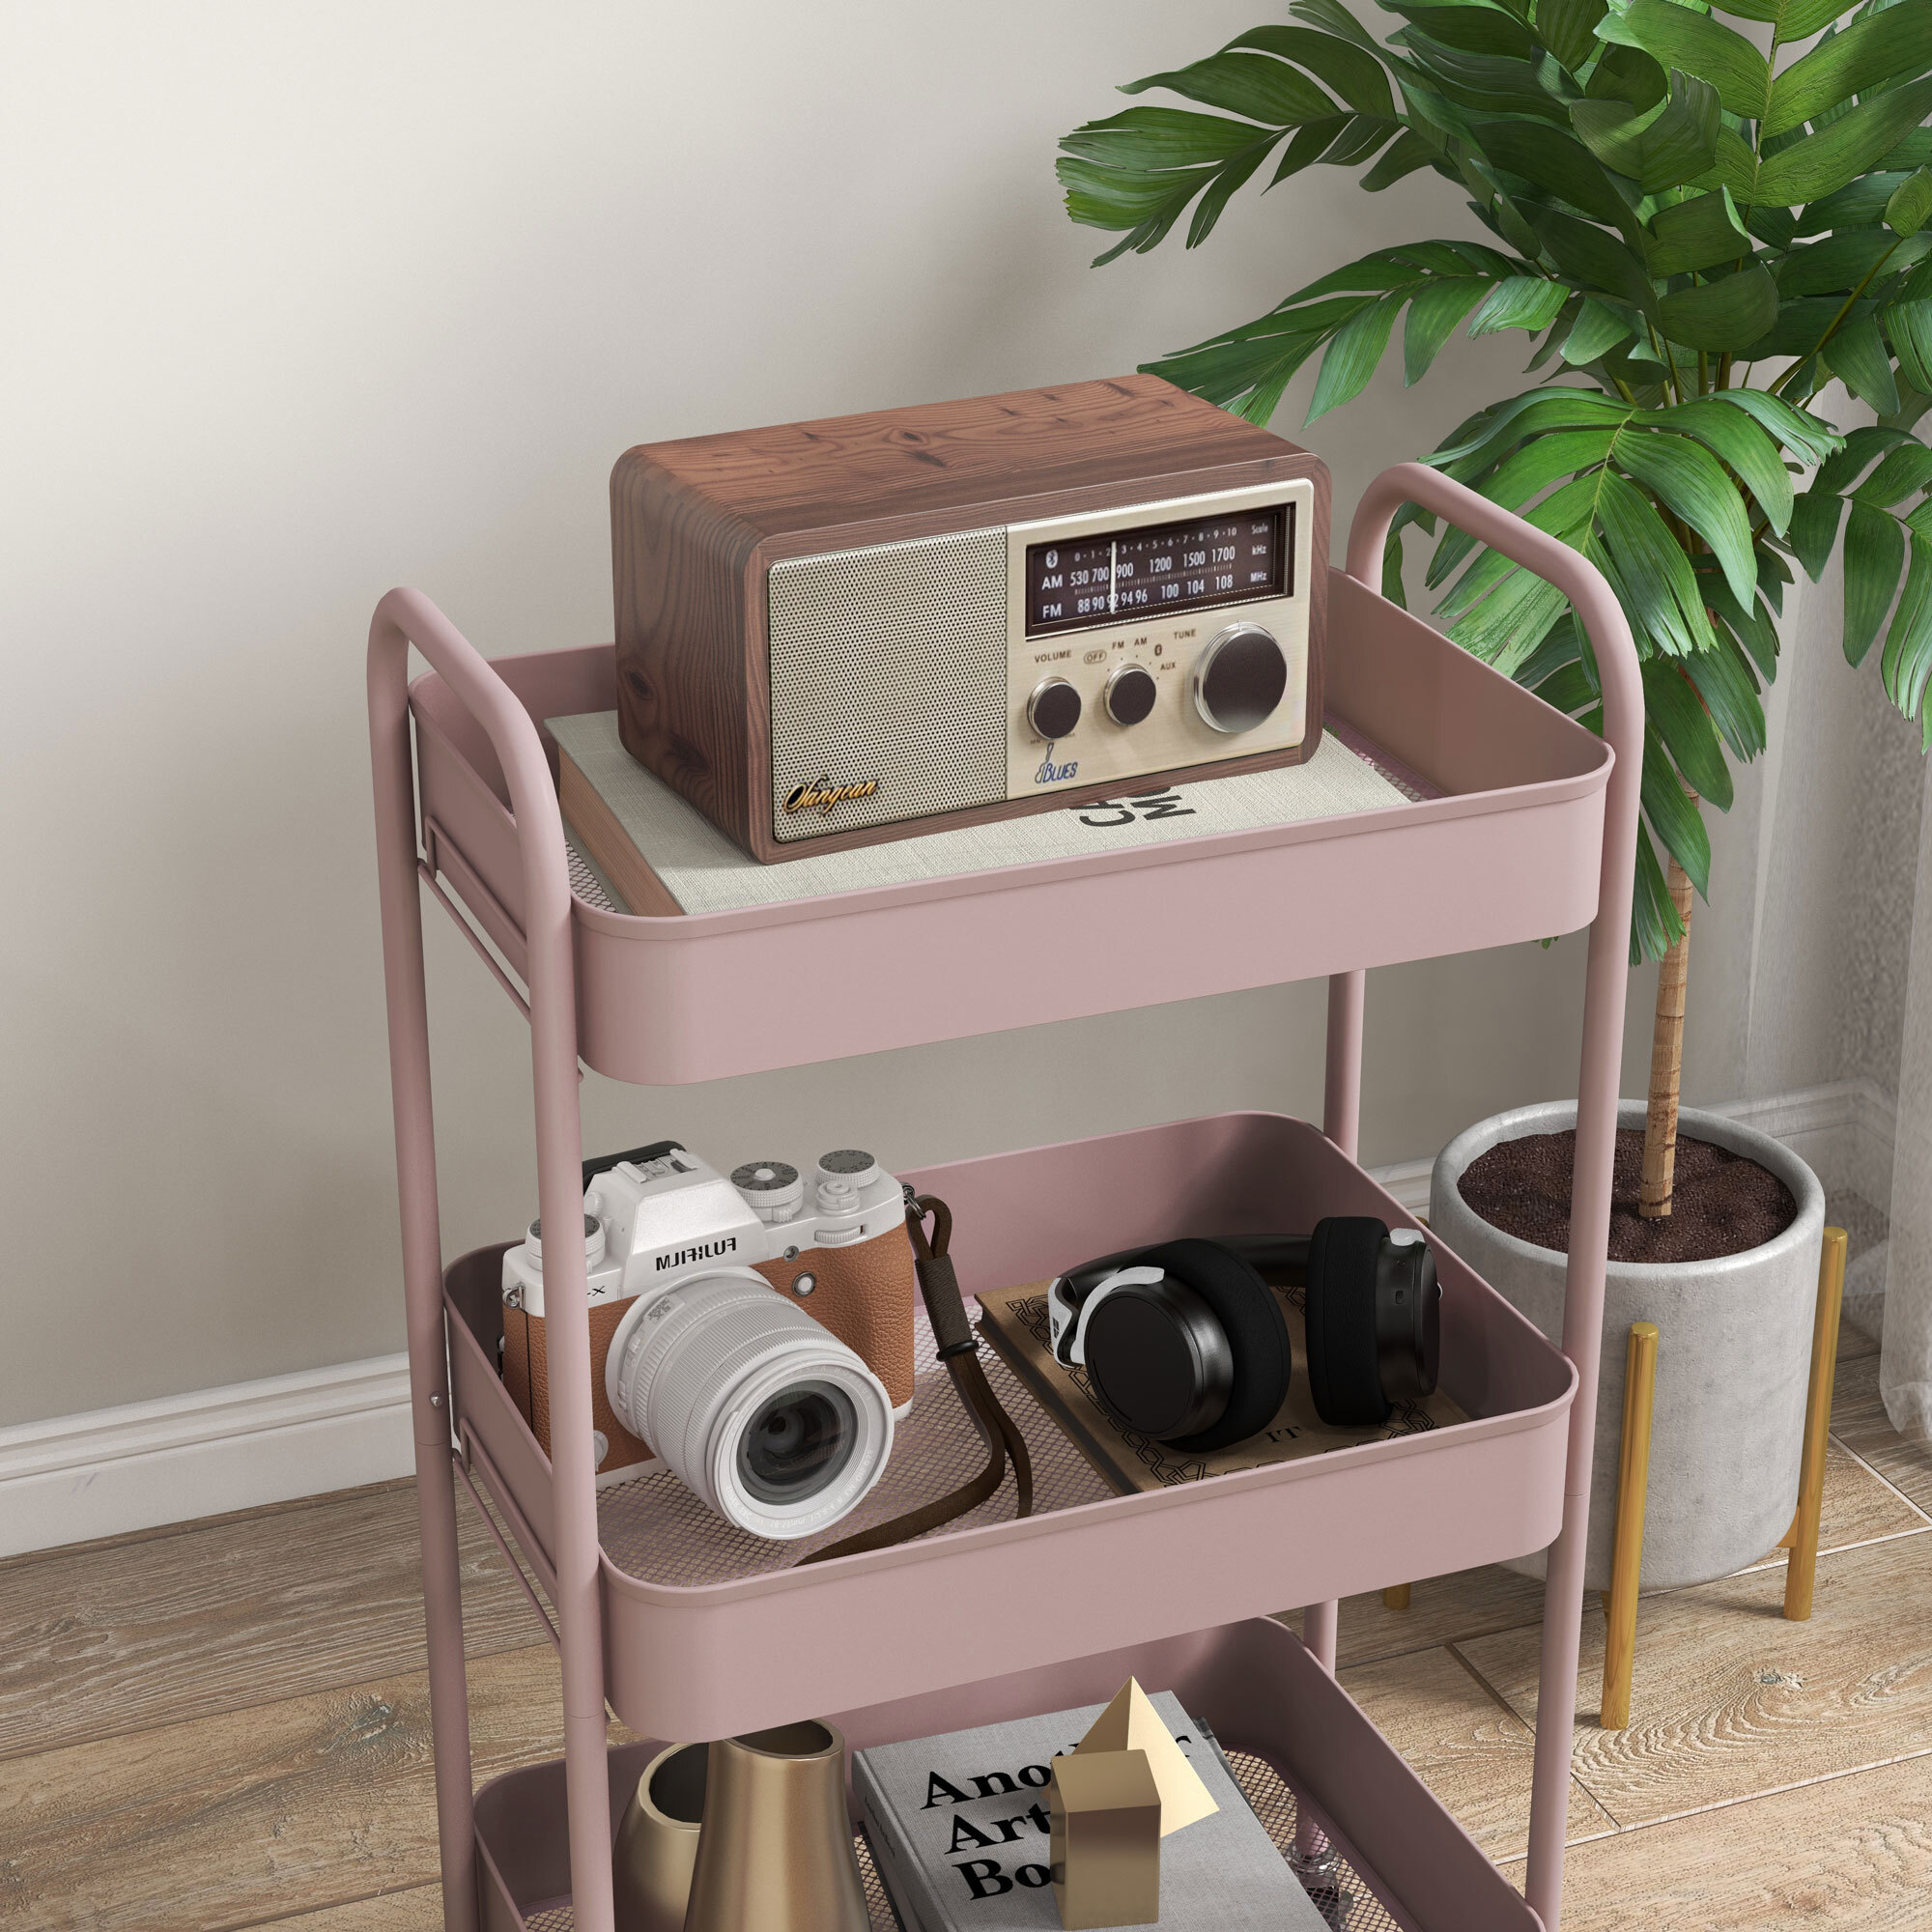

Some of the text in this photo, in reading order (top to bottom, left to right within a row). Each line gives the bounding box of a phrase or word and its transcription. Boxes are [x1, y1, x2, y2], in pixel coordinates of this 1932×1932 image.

[1122, 544, 1127, 554] 3
[1137, 542, 1142, 551] 4
[1152, 540, 1158, 550] 5
[1168, 537, 1174, 547] 6
[1183, 534, 1188, 544] 7
[1213, 529, 1219, 540] 9
[1227, 527, 1237, 537] 10
[1041, 545, 1267, 590] AM 530 700 900 1200 1500 1700 kHz
[1042, 603, 1062, 619] FM
[1077, 598, 1091, 613] 88
[1092, 595, 1105, 611] 90
[1121, 591, 1133, 607] 94
[1135, 588, 1149, 604] 96
[1161, 582, 1179, 600] 100
[1187, 579, 1205, 595] 104
[1215, 574, 1234, 590] 108
[1250, 571, 1267, 582] MHz
[1112, 637, 1148, 650] FM AM
[1174, 629, 1197, 639] TUNE
[1035, 649, 1072, 664] VOLUME
[1087, 652, 1104, 663] OFF
[1160, 662, 1177, 670] AUX
[1042, 761, 1078, 783] BLUES
[944, 1802, 1051, 1855] Art
[952, 1859, 1052, 1901] Bo
